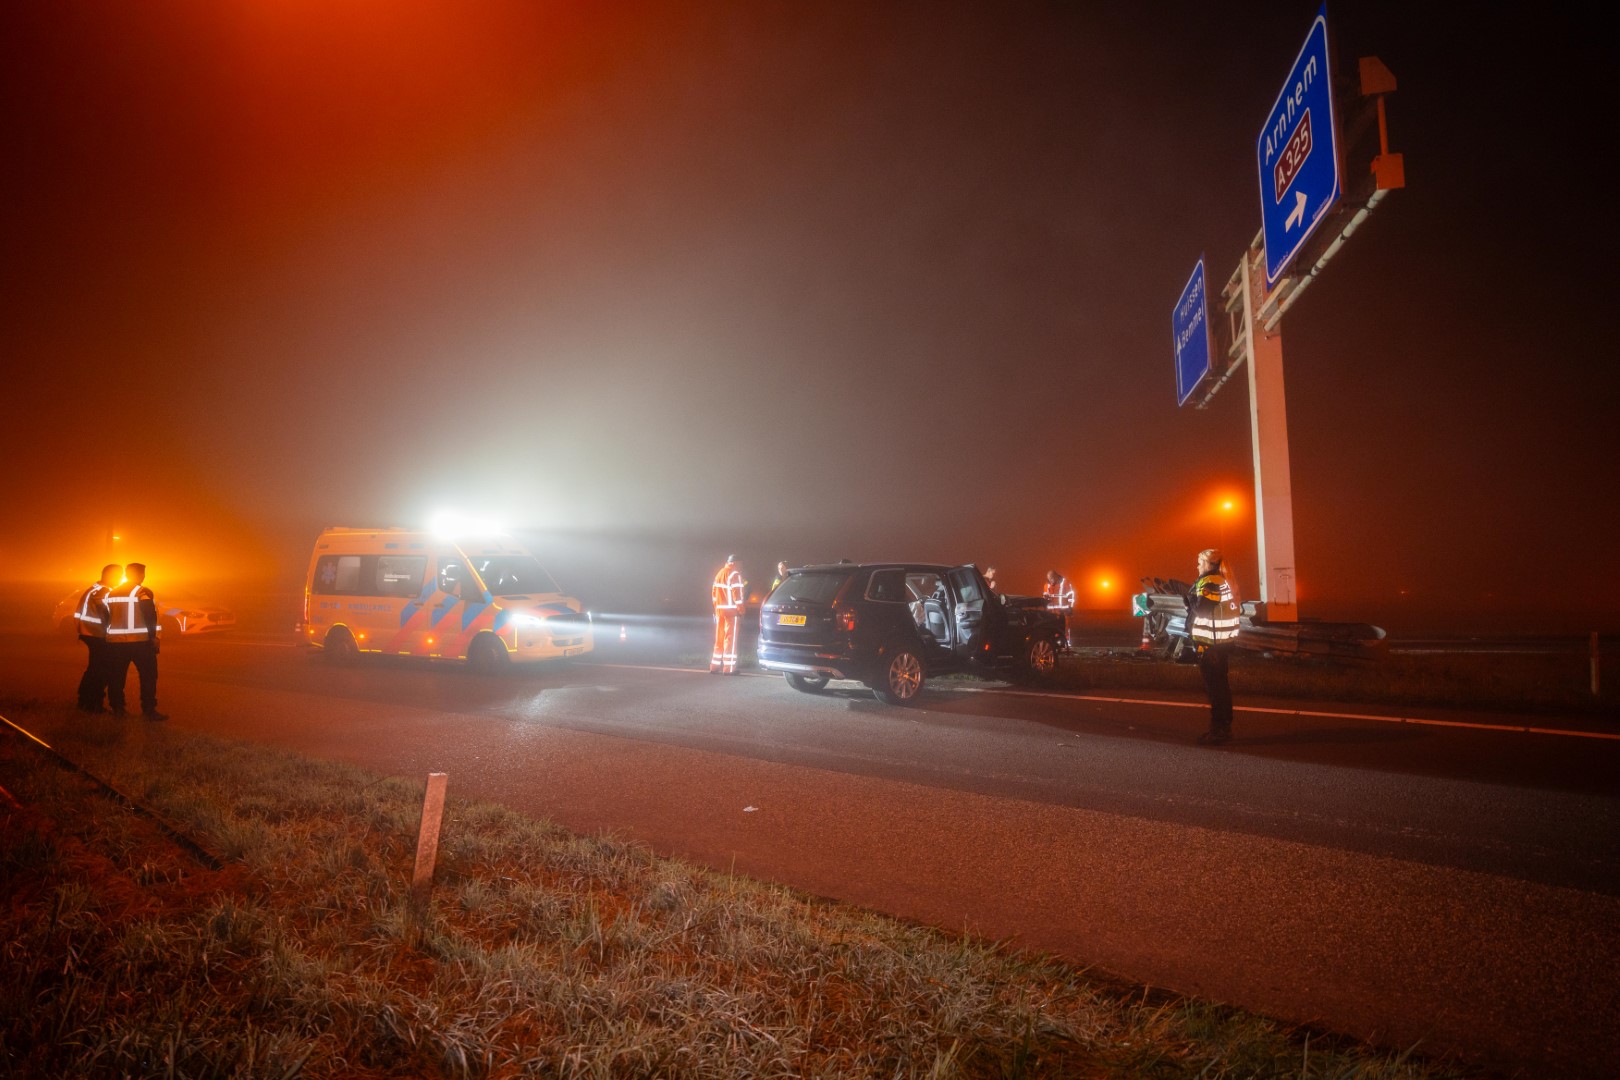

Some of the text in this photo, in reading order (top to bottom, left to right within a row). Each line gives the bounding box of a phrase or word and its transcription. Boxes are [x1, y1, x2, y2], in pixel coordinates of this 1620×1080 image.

[1265, 55, 1317, 166] Arnhem
[1278, 122, 1309, 193] A 325
[1180, 276, 1203, 323] Huissen
[1181, 298, 1204, 349] Bemmel
